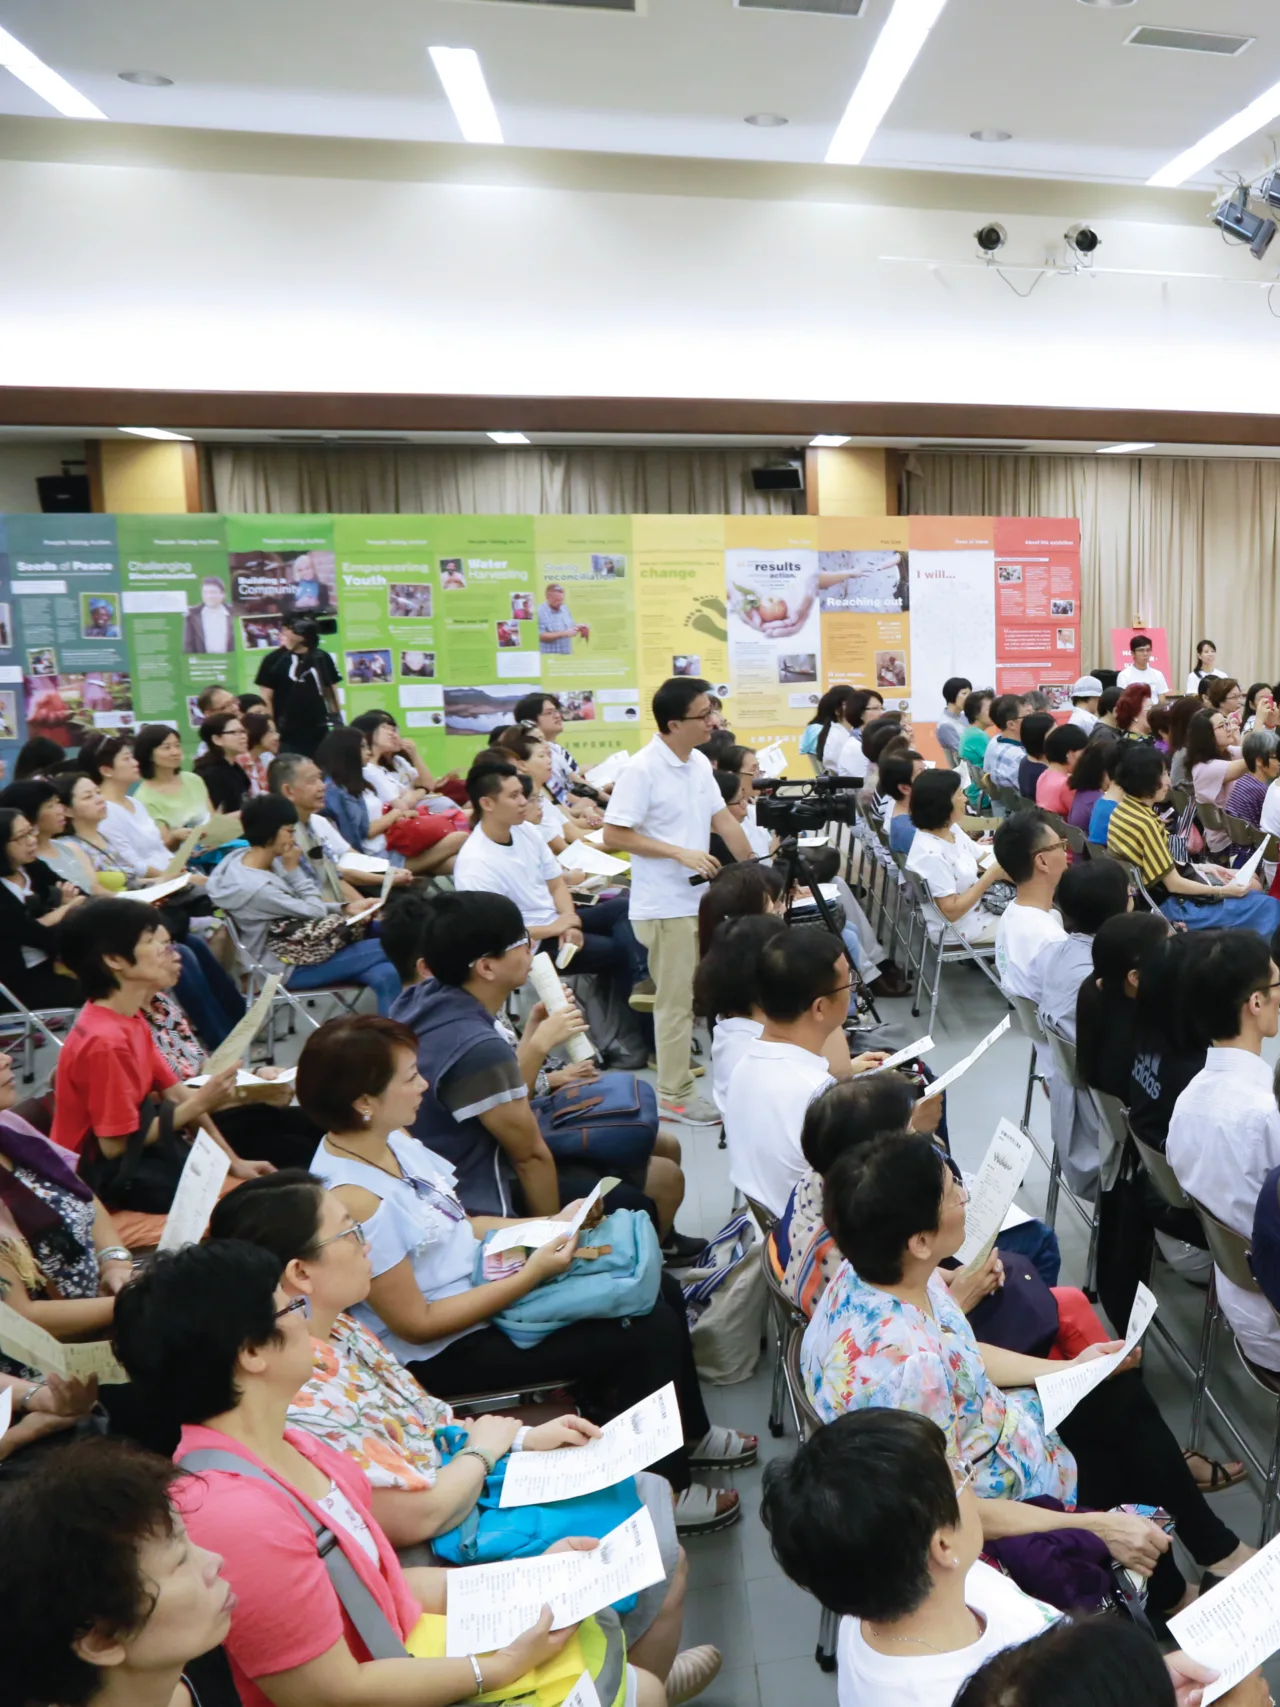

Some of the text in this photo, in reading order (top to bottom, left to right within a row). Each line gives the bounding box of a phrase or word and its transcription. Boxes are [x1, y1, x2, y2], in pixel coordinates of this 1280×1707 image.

[16, 561, 58, 571] Seeds
[72, 561, 113, 571] Peace
[128, 560, 192, 573] Challenging
[342, 562, 429, 574] Empowering
[467, 559, 508, 569] Water
[755, 562, 801, 571] results
[468, 570, 528, 581] Harvesting
[544, 573, 616, 581] reconciliation
[640, 567, 696, 580] change
[916, 570, 920, 579] I
[237, 576, 278, 585] Building
[342, 574, 387, 586] Youth
[238, 584, 302, 596] Community
[827, 597, 903, 607] Reaching out
[1131, 1058, 1161, 1100] didas
